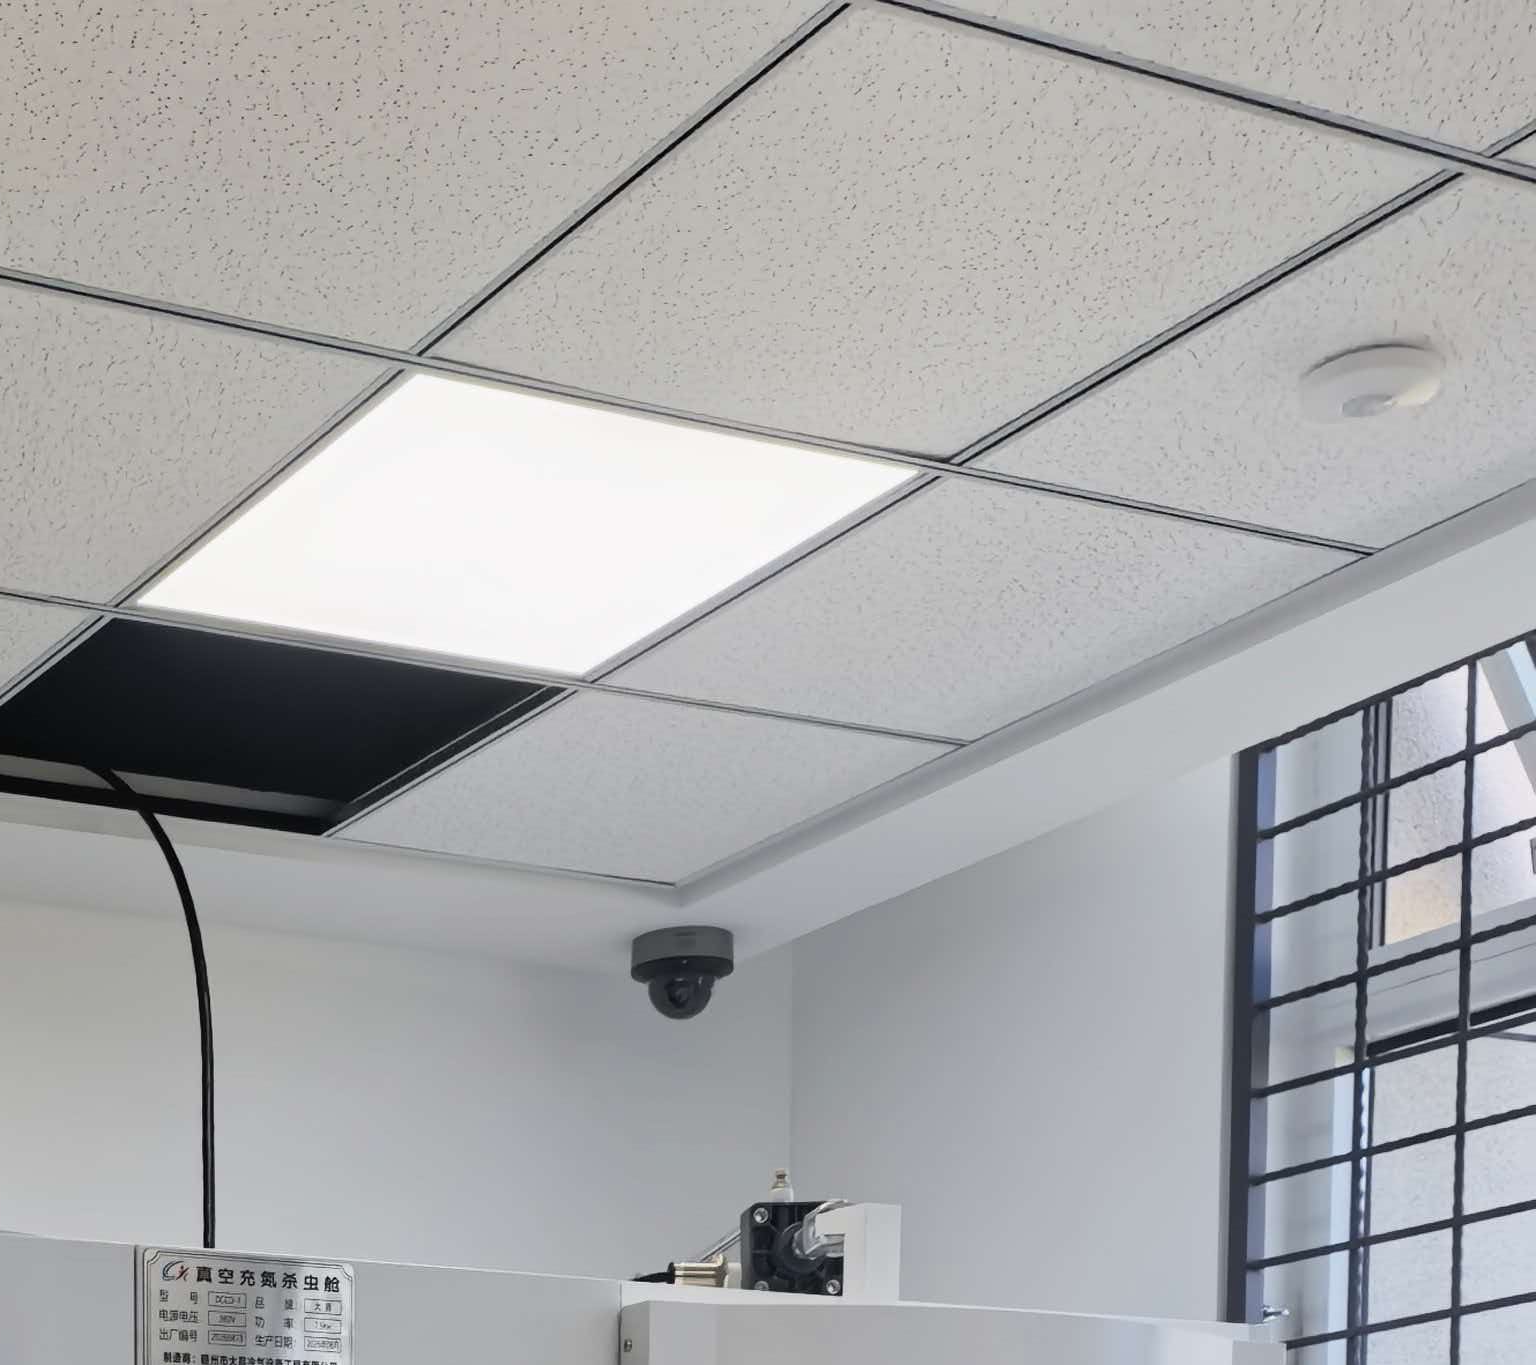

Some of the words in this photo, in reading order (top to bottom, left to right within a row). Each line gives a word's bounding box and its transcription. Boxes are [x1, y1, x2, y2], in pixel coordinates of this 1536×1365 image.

[196, 1266, 340, 1293] 真空充氮杀虫舱
